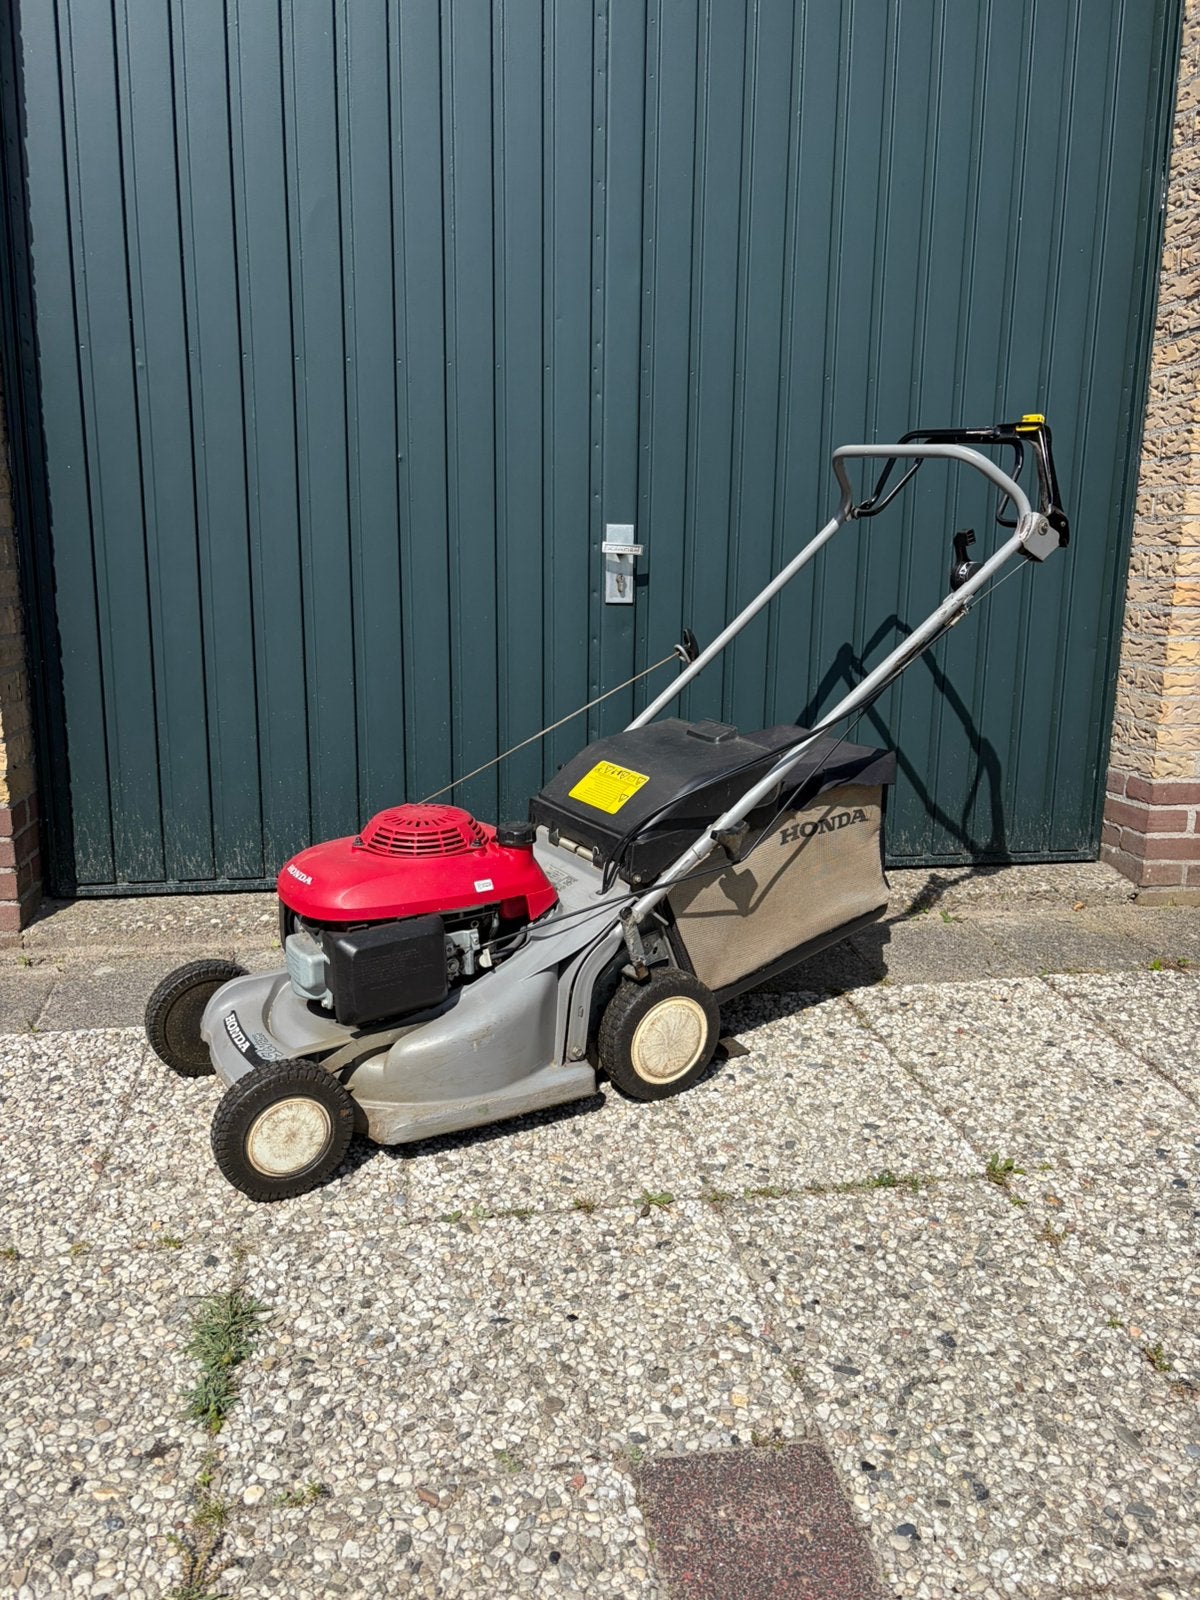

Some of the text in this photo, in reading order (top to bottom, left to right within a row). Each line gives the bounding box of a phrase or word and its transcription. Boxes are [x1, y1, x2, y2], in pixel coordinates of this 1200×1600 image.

[780, 808, 868, 846] HONDA
[287, 864, 313, 886] HONDA
[225, 1013, 251, 1053] HONDA
